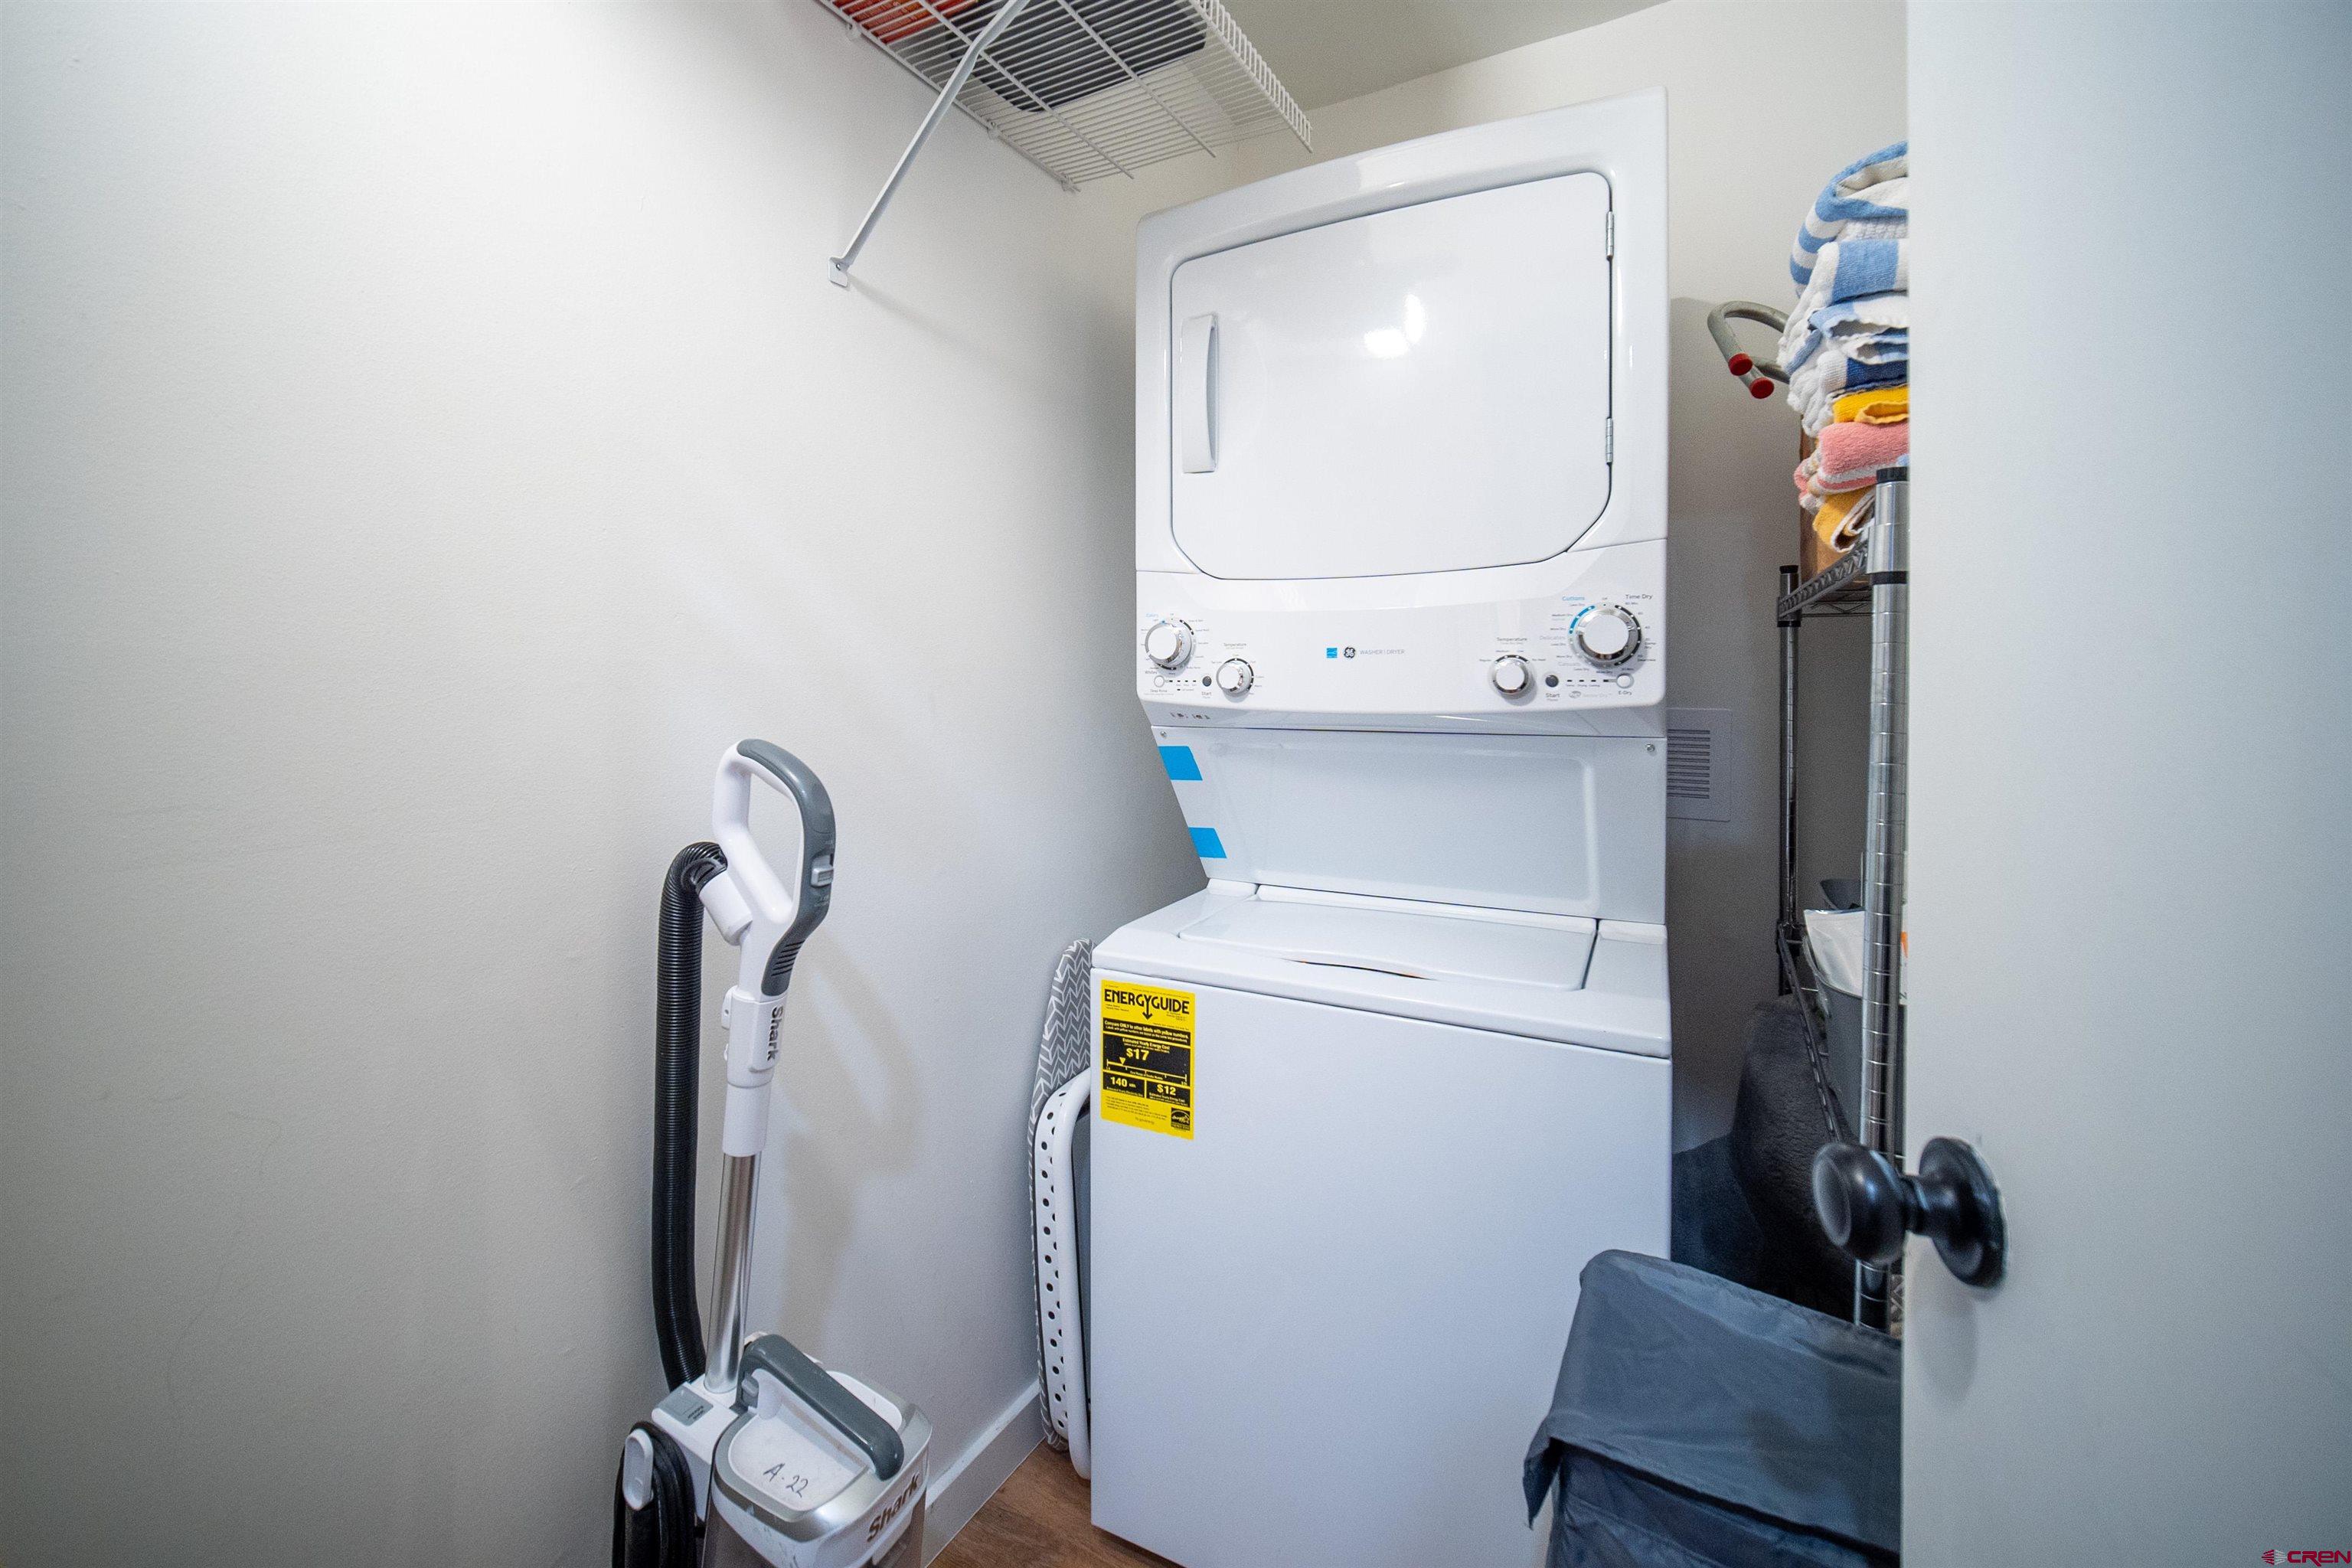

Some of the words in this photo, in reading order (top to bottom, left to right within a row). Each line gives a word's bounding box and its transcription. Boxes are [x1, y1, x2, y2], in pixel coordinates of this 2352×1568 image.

[1104, 988, 1190, 1015] ENERGYGUIDE
[767, 1005, 783, 1061] Shark
[1126, 1047, 1149, 1061] $17
[1110, 1076, 1127, 1087] 140
[1157, 1083, 1176, 1096] $12
[867, 1472, 920, 1543] Shark
